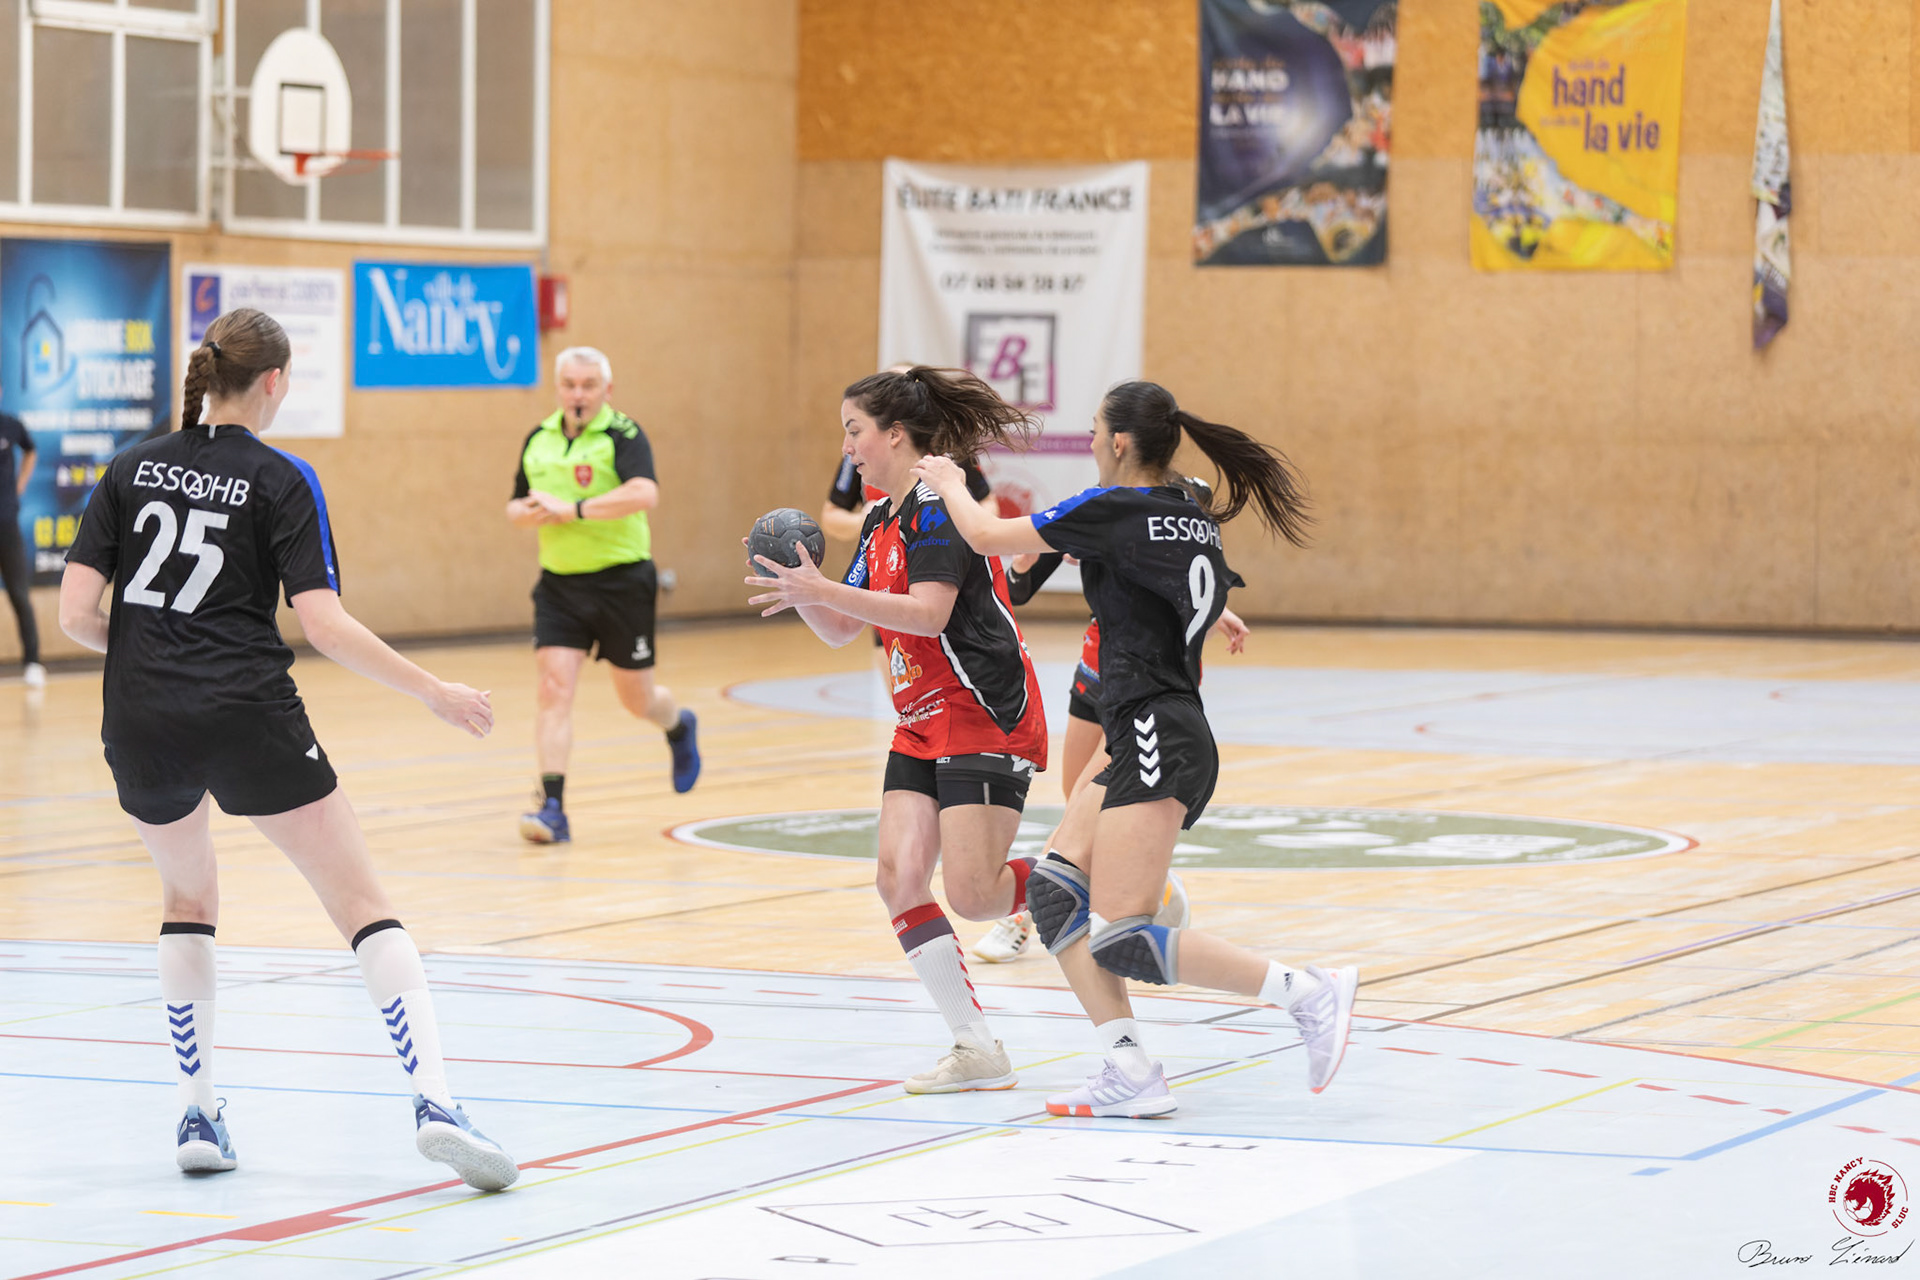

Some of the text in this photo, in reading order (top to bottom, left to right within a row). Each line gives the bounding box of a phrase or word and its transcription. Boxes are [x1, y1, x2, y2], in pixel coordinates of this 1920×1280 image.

[1552, 63, 1626, 108] hand
[1584, 110, 1660, 153] la vie
[366, 267, 521, 381] Nancy
[123, 500, 230, 615] 25
[1185, 554, 1216, 647] 9
